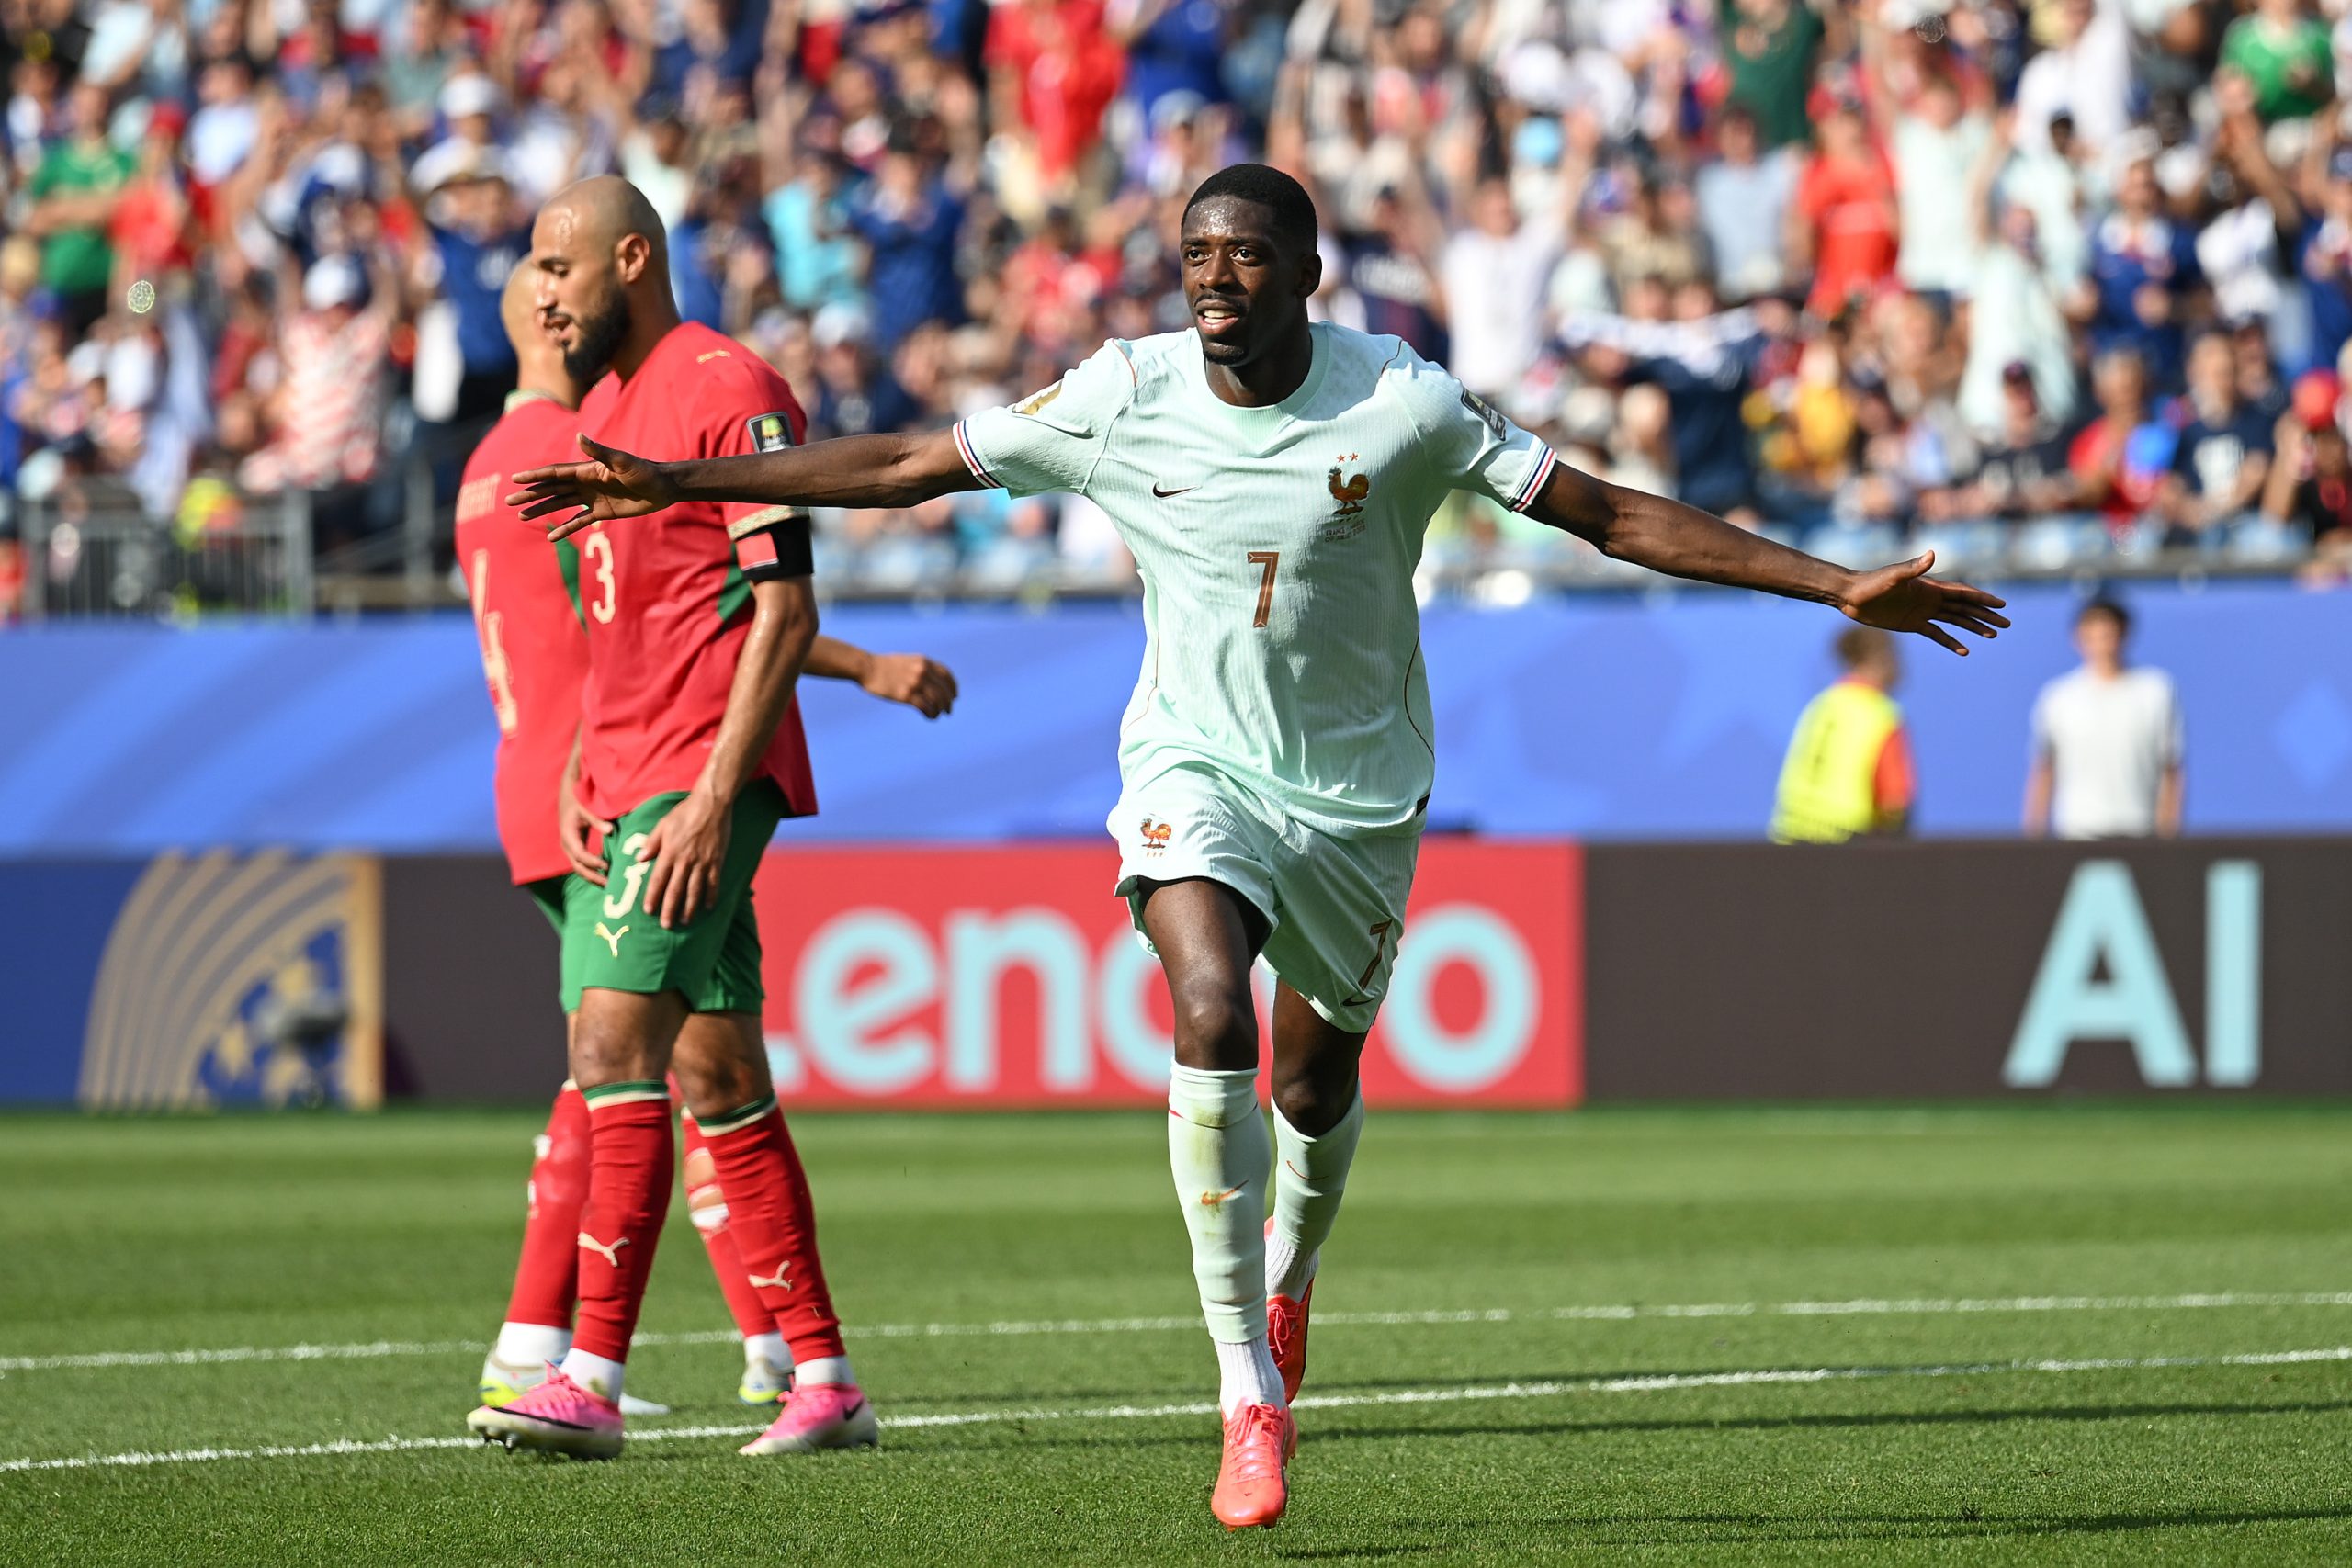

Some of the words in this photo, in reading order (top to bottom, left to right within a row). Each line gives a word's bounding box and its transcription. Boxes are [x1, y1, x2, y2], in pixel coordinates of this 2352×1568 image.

[585, 531, 616, 625] 3
[1247, 551, 1280, 628] 7
[603, 832, 651, 919] 3
[1358, 919, 1393, 991] 7
[2003, 860, 2264, 1088] AI
